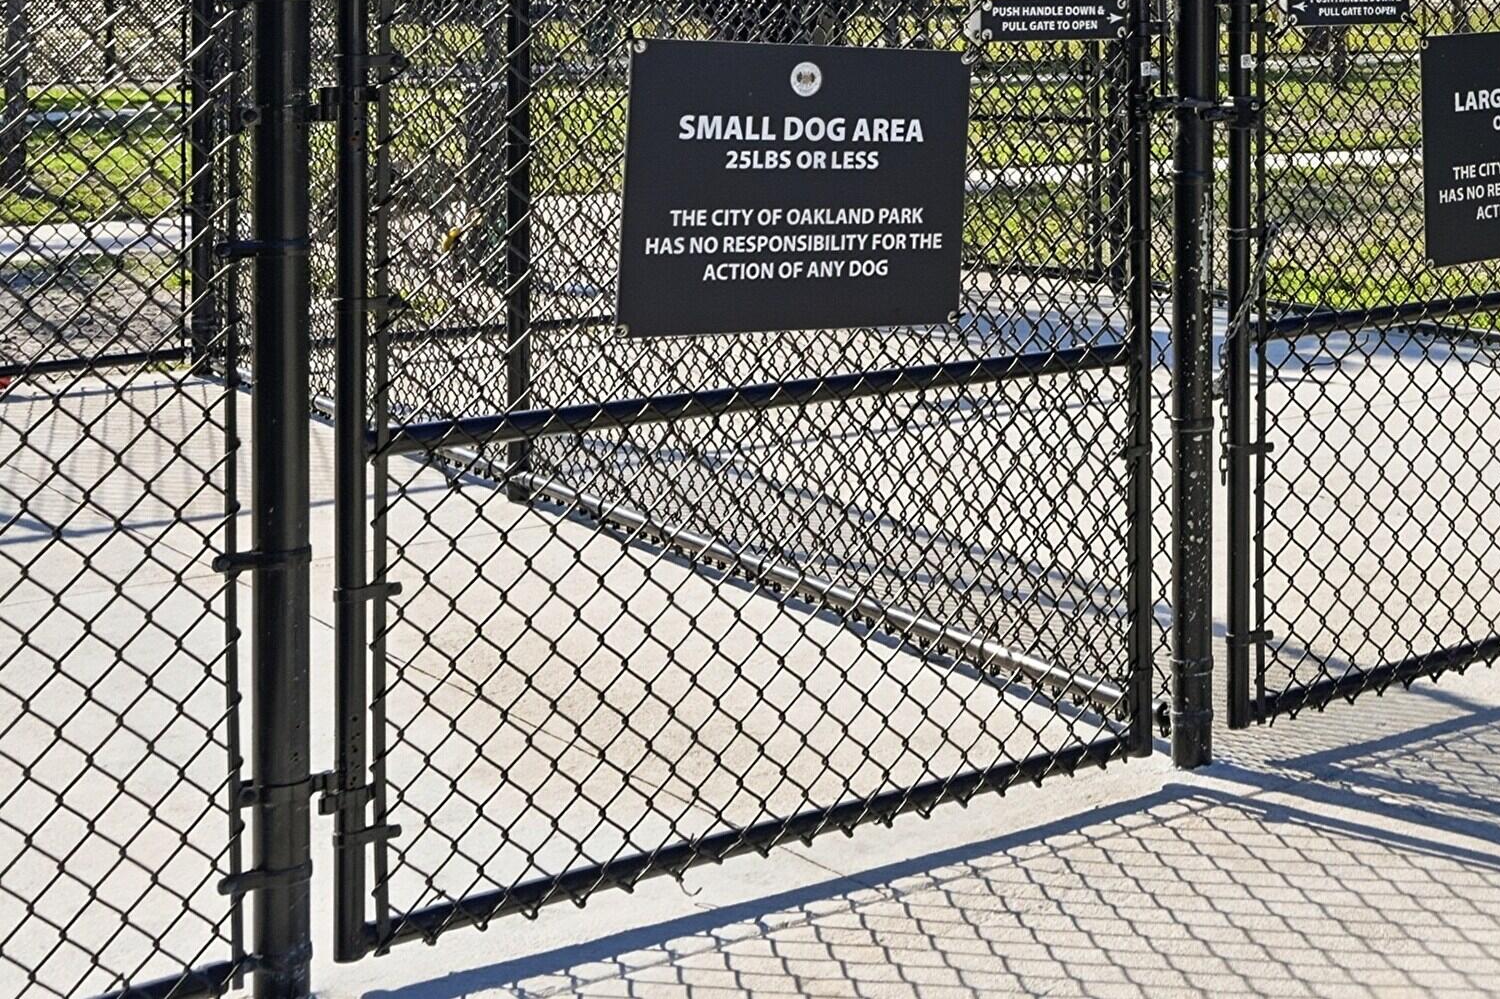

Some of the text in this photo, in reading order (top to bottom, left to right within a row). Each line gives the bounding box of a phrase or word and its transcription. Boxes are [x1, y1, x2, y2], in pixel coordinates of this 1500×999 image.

[993, 6, 1105, 16] PUSH HANDLE DOWN &
[1319, 8, 1340, 16] PULL
[1341, 7, 1361, 16] GATE
[1363, 7, 1374, 15] TO
[1002, 20, 1097, 31] PULL GATE TO OPEN
[679, 115, 923, 142] SMALL DOG AREA
[726, 151, 879, 169] 25LBS OR LESS
[1453, 165, 1476, 180] THE
[1440, 187, 1464, 203] HAS
[1467, 185, 1484, 200] NO
[670, 208, 923, 226] THE CITY OF OAKLAND PARK
[646, 233, 942, 254] HAS NO RESPONSIBILITY FOR THE
[703, 260, 888, 281] ACTION OF ANY DOG
